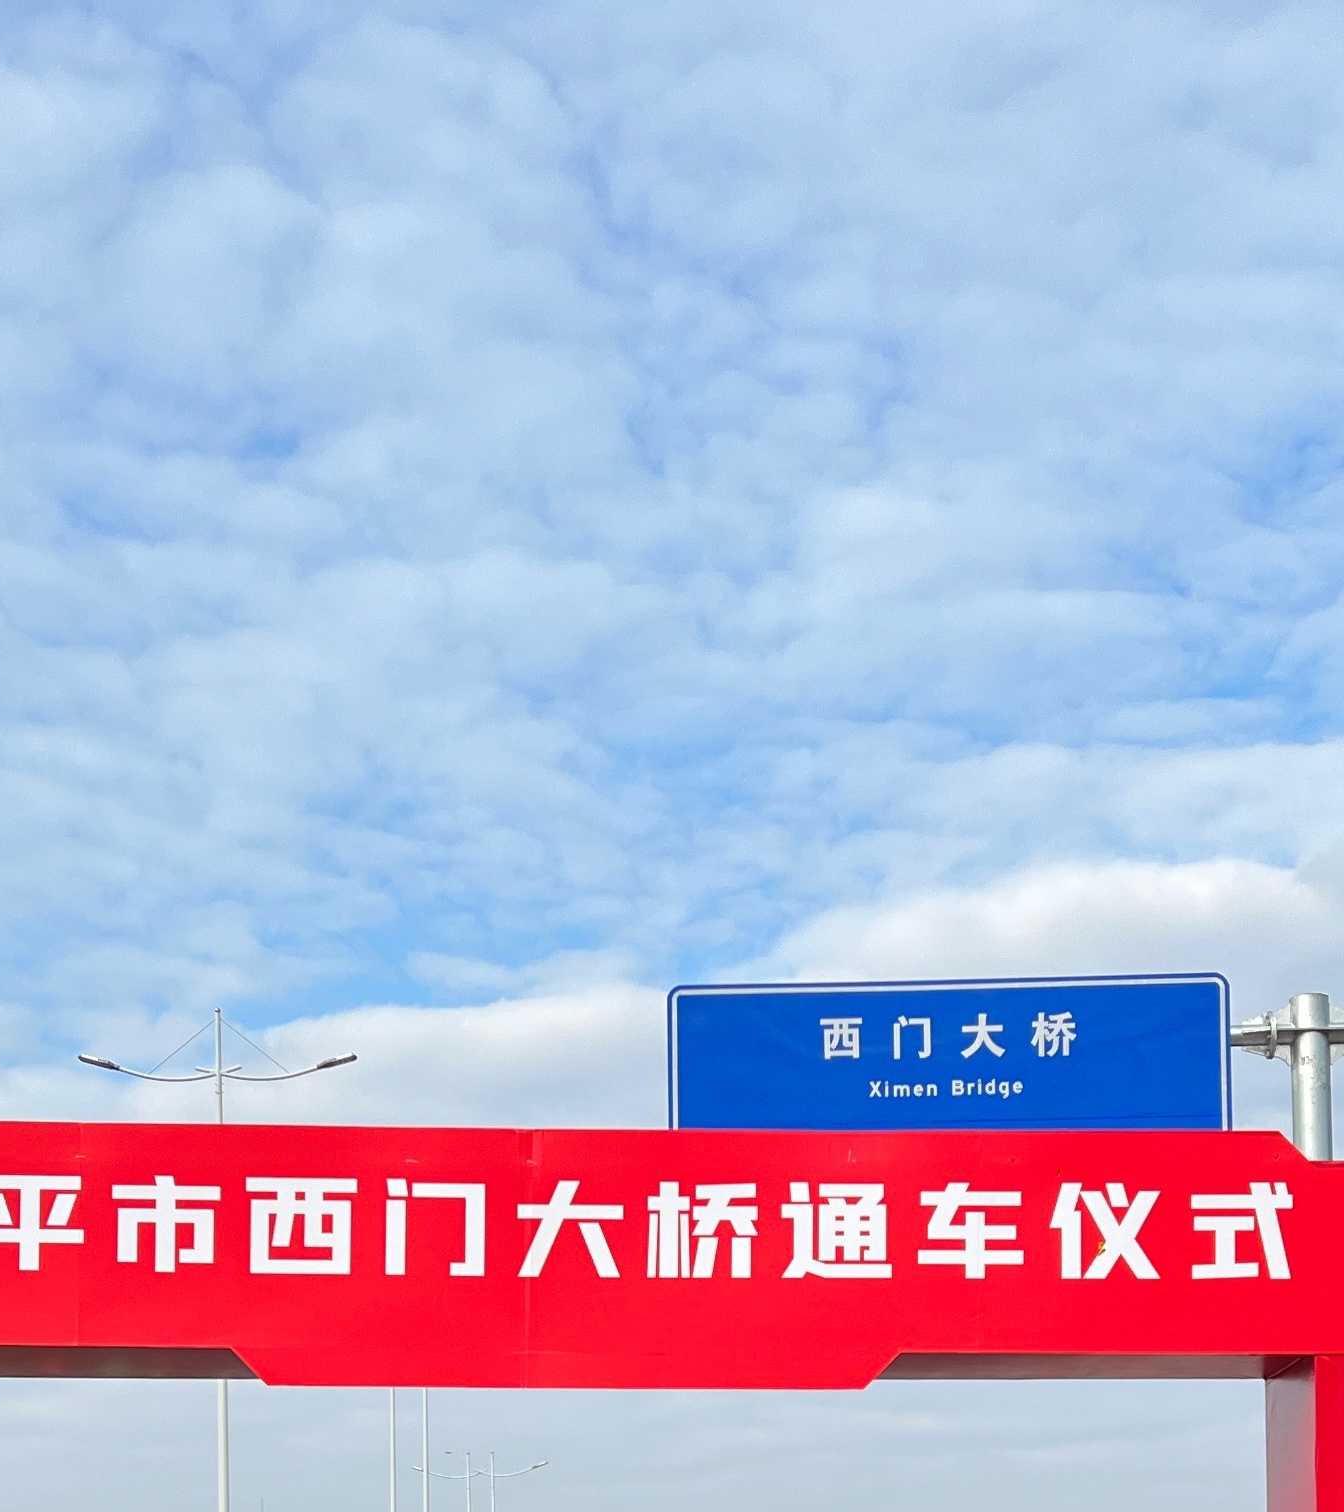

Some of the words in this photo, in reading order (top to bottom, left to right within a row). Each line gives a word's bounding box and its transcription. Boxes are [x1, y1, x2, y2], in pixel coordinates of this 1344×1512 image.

[819, 1011, 1077, 1060] 西门大桥
[869, 1081, 939, 1098] Ximen
[952, 1078, 1024, 1100] Bridge
